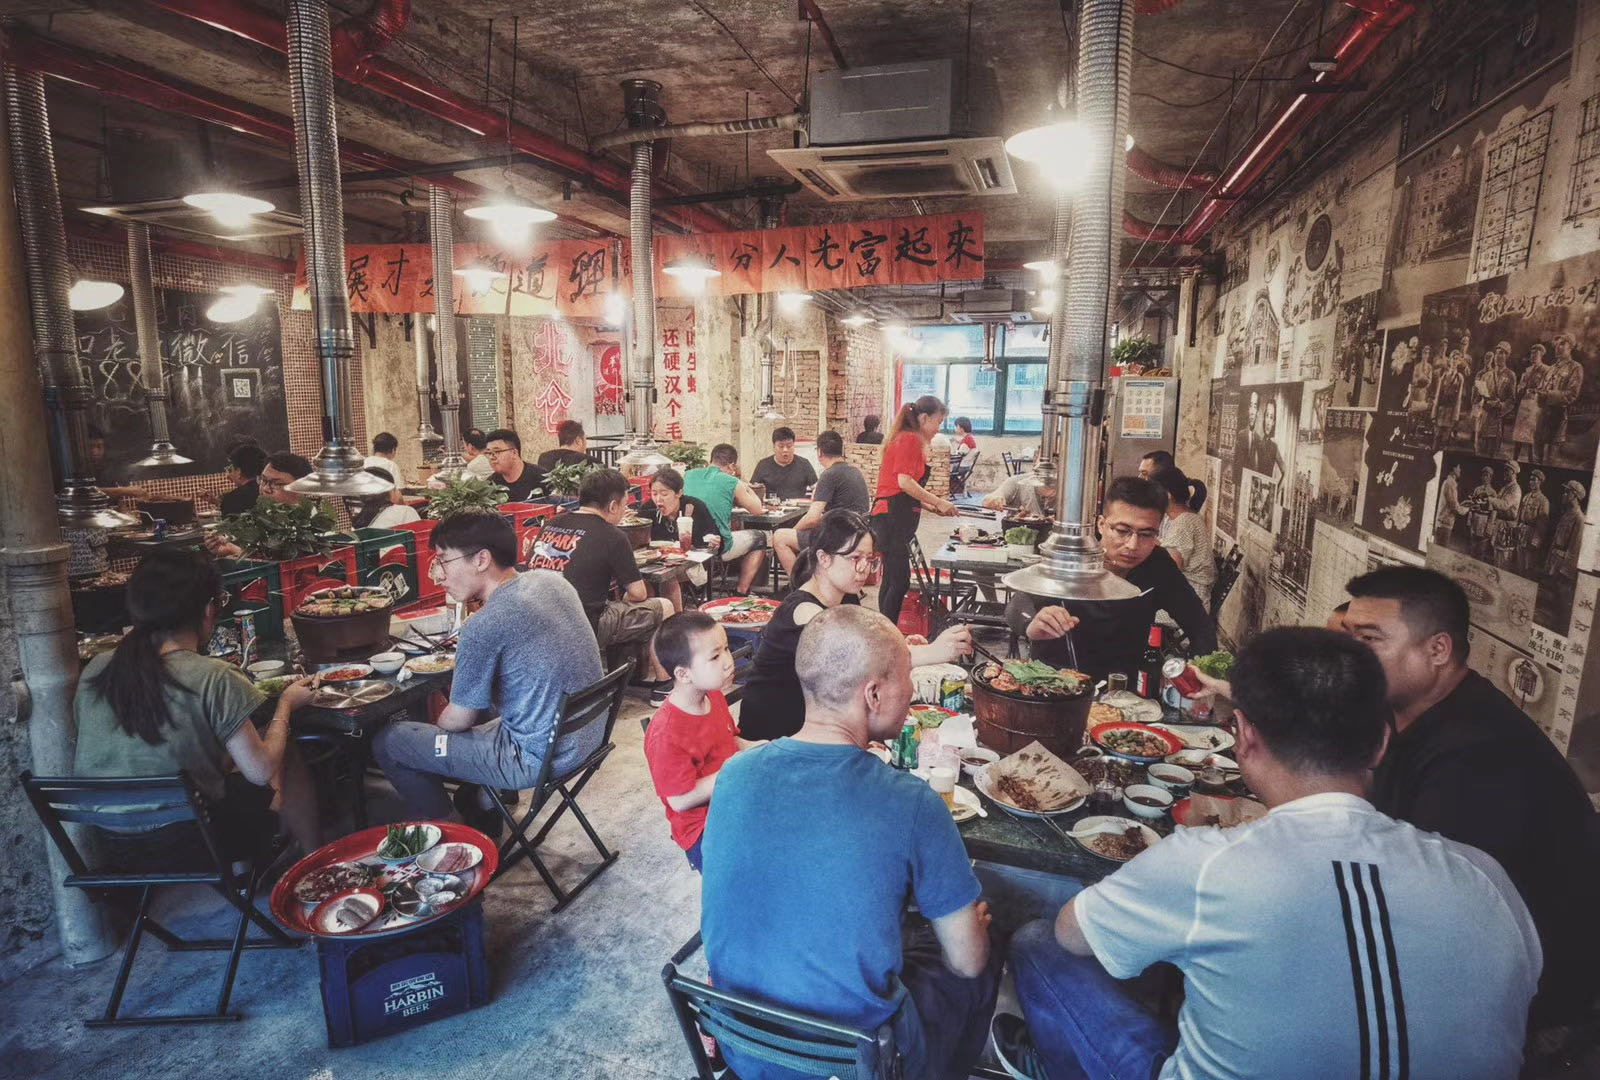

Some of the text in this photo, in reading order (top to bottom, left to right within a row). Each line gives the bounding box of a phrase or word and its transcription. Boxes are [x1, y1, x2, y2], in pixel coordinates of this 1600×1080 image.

[662, 327, 683, 441] 还硬汉个毛
[384, 985, 445, 1013] HARBIN
[402, 1002, 430, 1017] BEER
